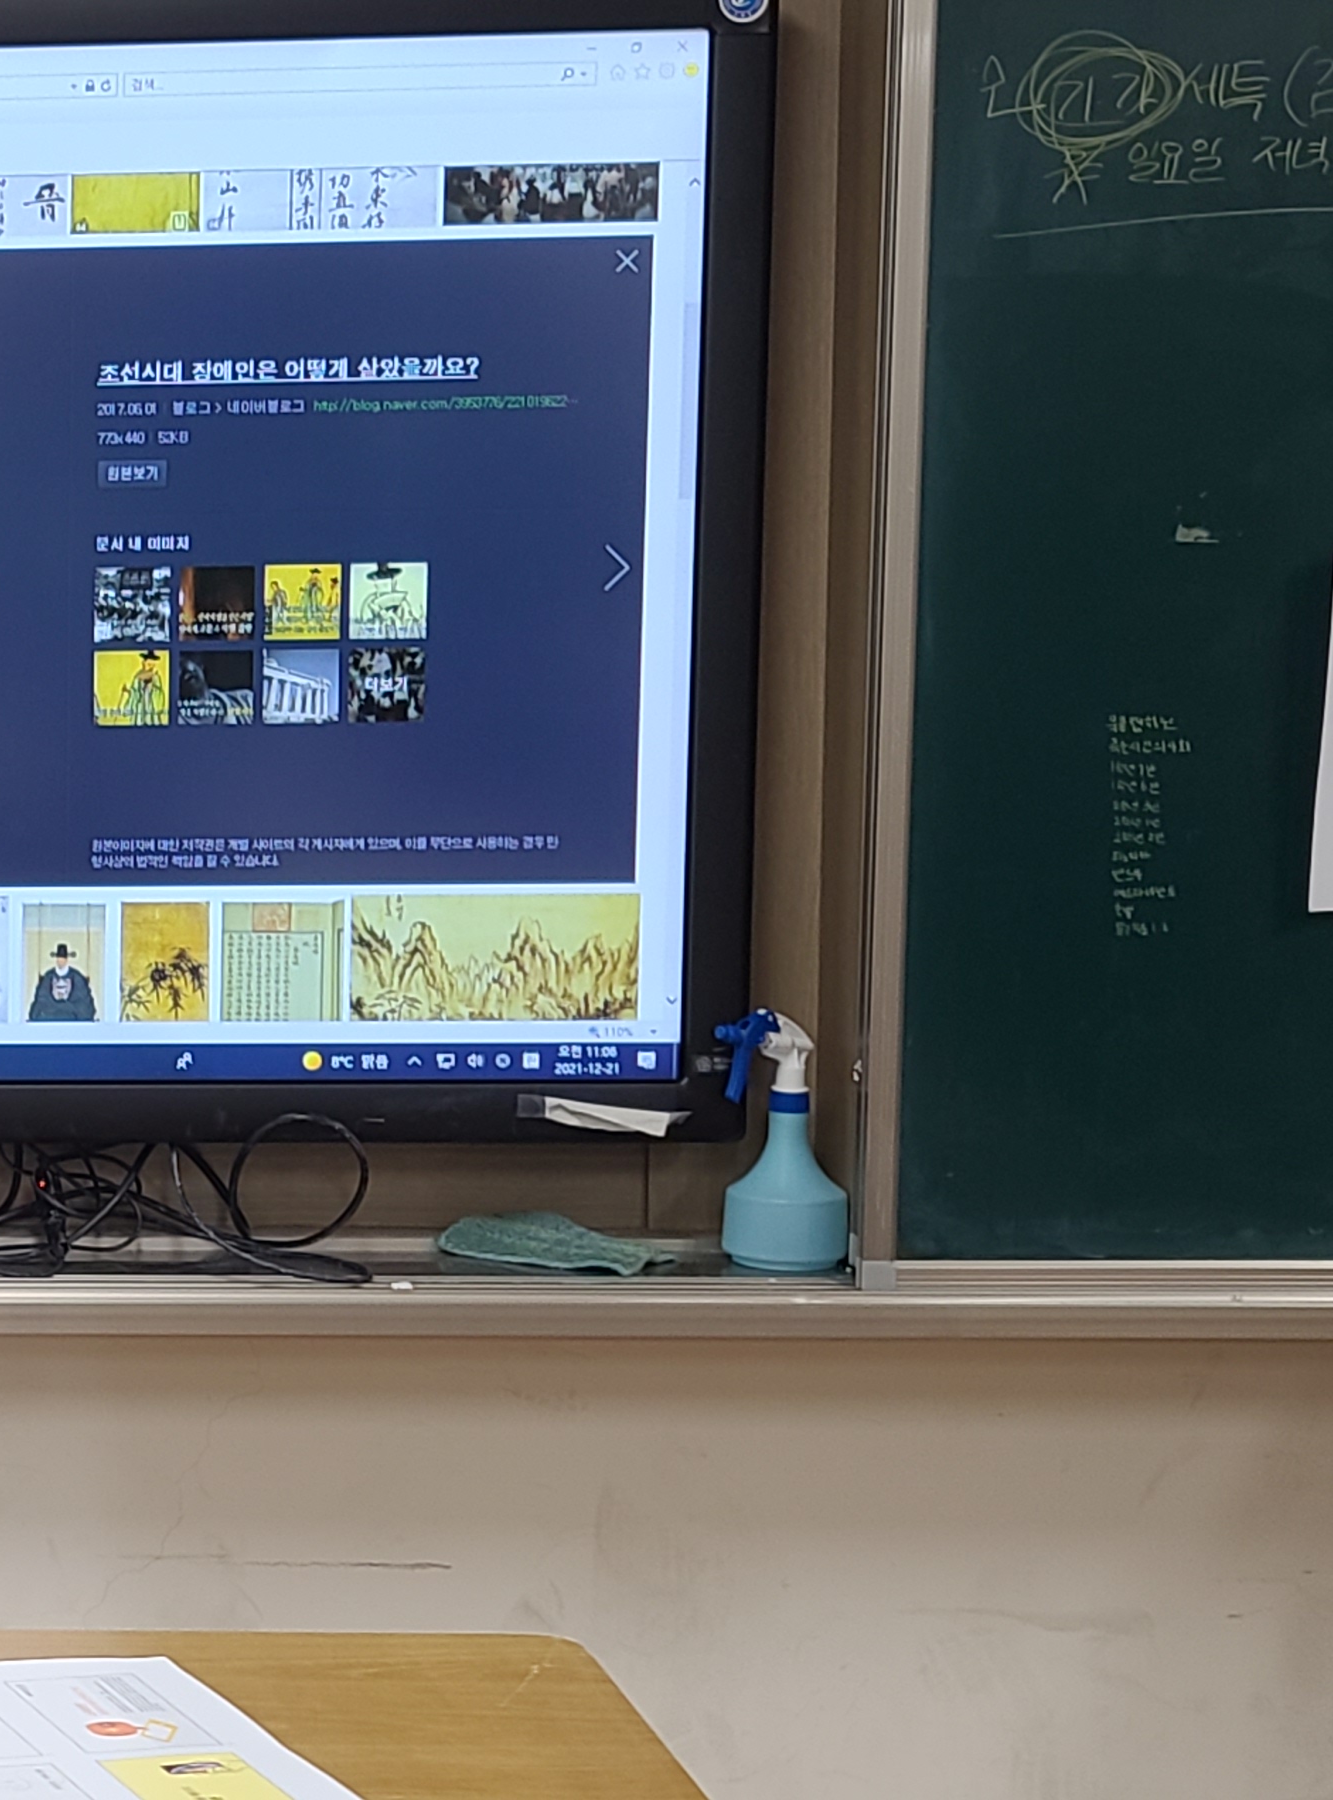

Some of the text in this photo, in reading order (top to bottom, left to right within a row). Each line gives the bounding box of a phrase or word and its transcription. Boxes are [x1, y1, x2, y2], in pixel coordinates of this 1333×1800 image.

[1128, 136, 1330, 183] 일요일 저녁
[97, 354, 480, 384] 조선시대 장애인은 어떻게 살았을까요?
[172, 400, 212, 416] 블로그
[226, 399, 305, 415] 네이버블로그
[107, 465, 159, 482] 원본보기
[96, 534, 190, 552] 문서 내 이미지
[364, 676, 409, 693] 더보기
[220, 854, 231, 867] 수
[604, 1026, 633, 1038] 110%
[557, 1045, 583, 1059] 오전
[554, 1061, 621, 1076] 2021-12-21
